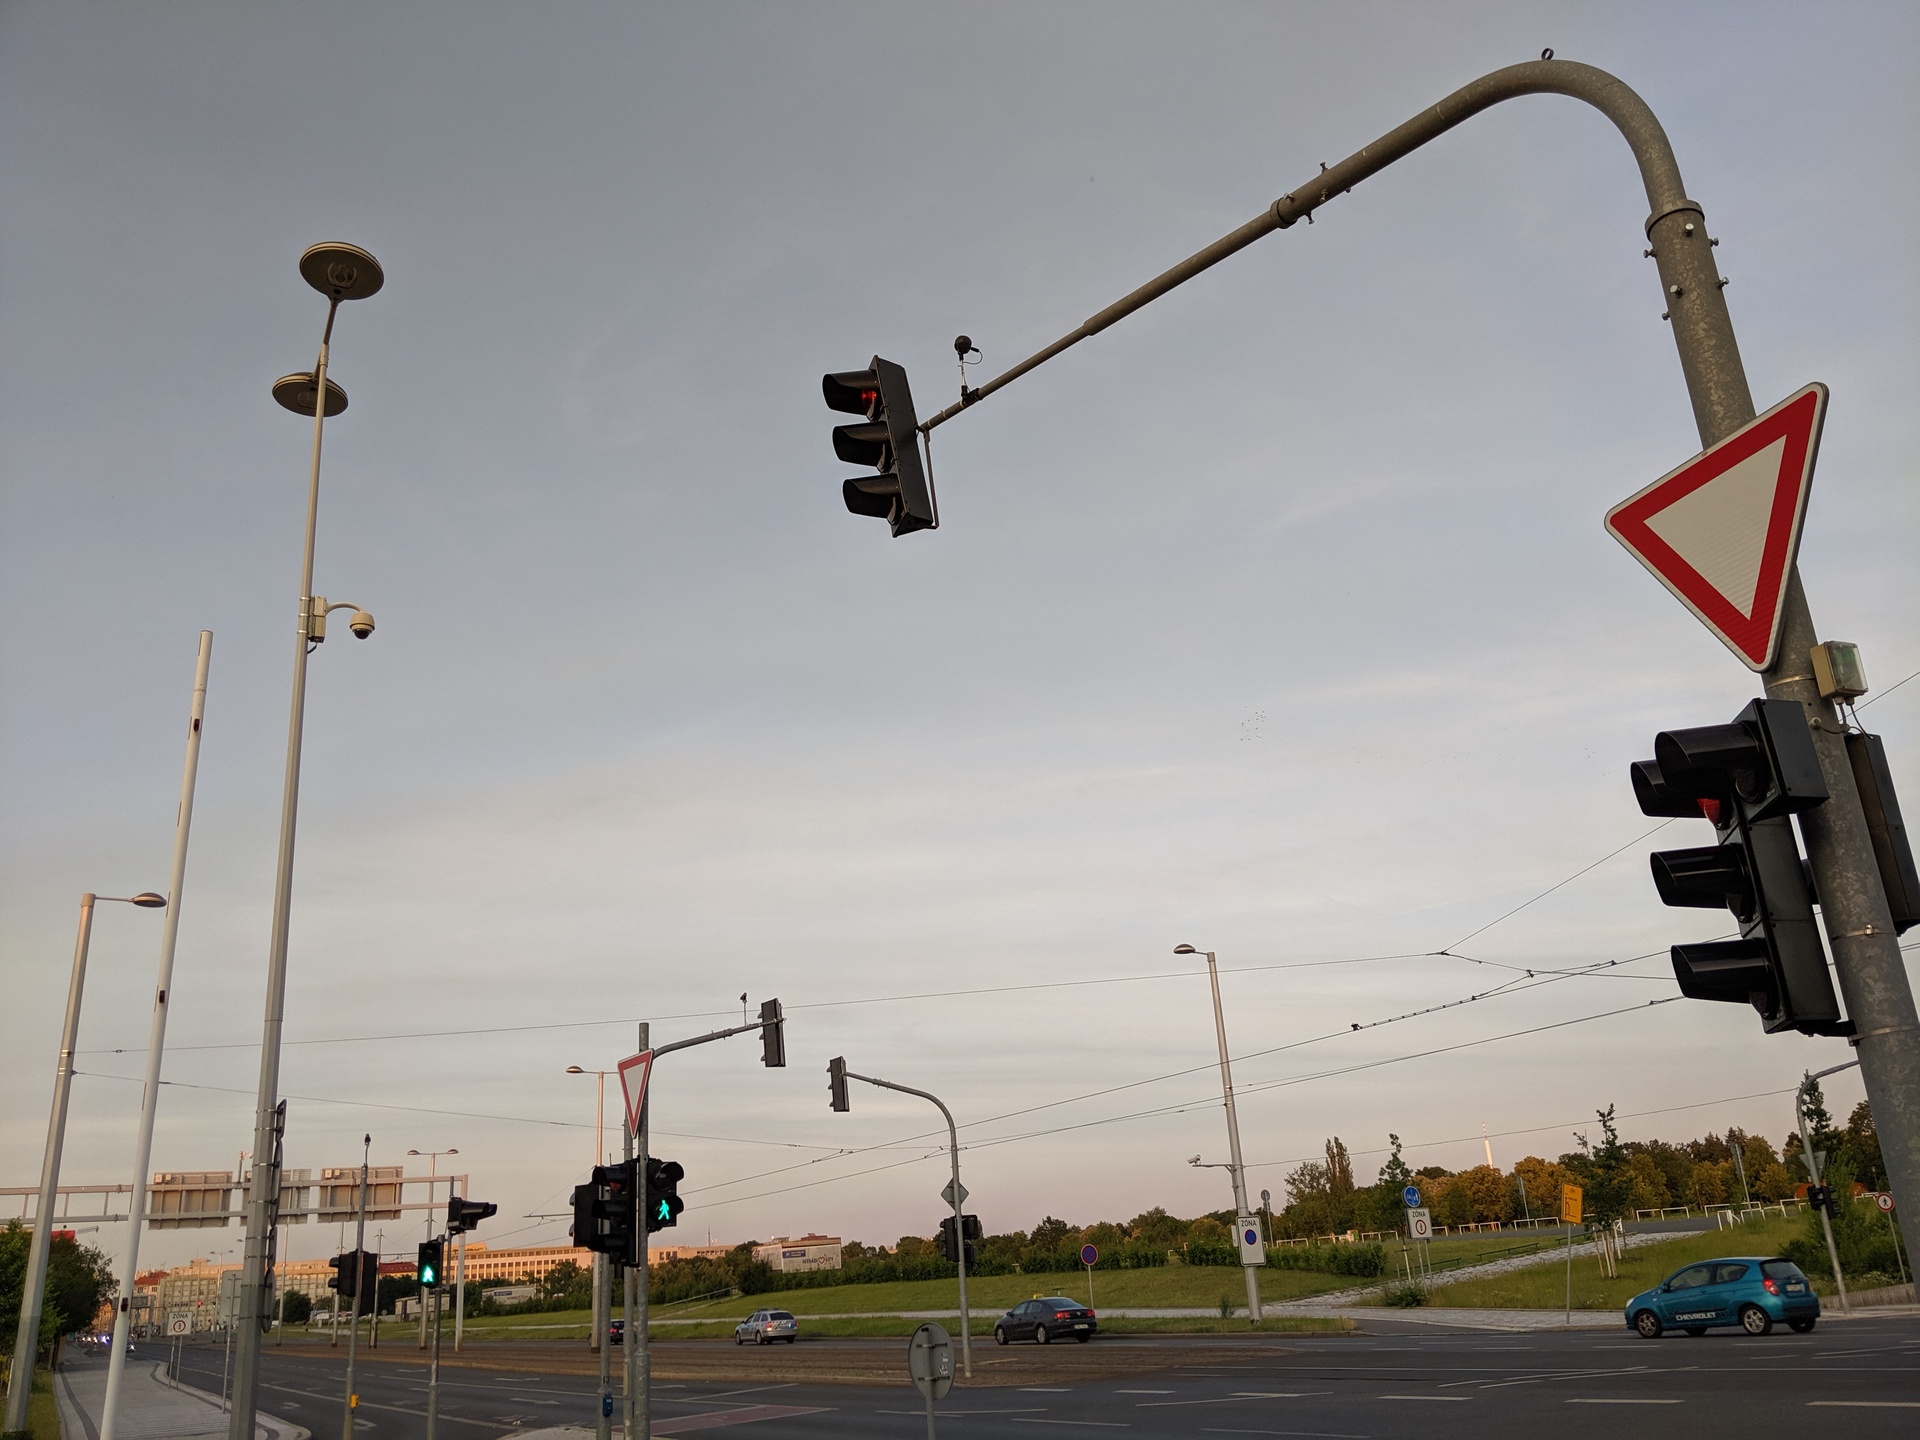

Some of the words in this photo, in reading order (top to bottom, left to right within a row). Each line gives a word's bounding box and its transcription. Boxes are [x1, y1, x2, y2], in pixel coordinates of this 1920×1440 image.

[1412, 1210, 1426, 1218] ZÓNA
[1241, 1218, 1257, 1227] ZÓNA
[1675, 1312, 1716, 1321] CHEVROLET
